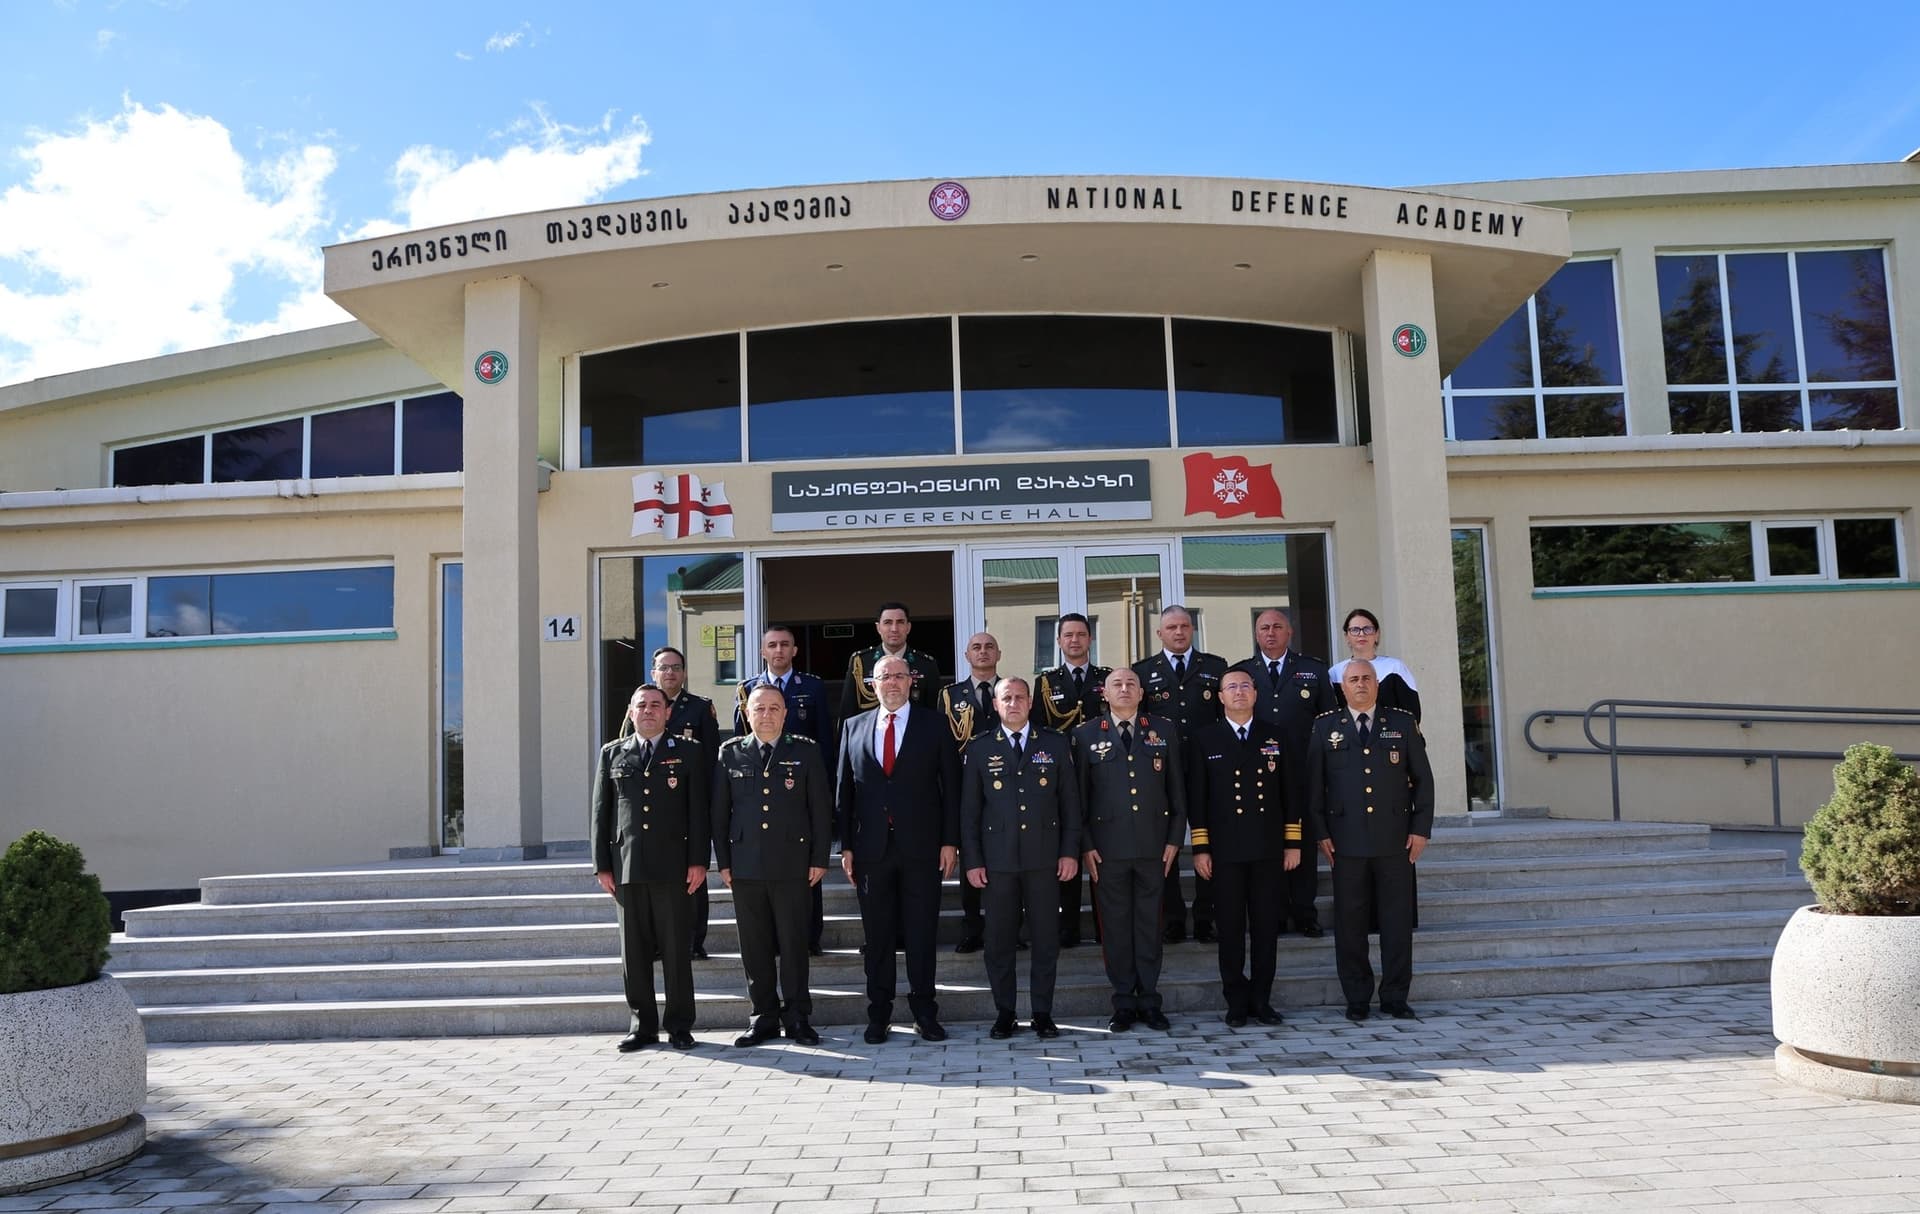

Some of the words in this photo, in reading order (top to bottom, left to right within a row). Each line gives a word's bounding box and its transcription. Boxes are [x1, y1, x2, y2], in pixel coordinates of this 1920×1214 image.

[1047, 187, 1182, 210] NATIONAL
[1232, 190, 1348, 219] DEFENCE
[1396, 202, 1524, 238] ACADEMY
[371, 229, 507, 271] ეროვნული
[546, 207, 688, 244] თავდაცვის
[728, 195, 851, 224] აკადემია
[788, 477, 1000, 498] საკონფერენციო
[1016, 473, 1134, 490] დარბაზი
[826, 510, 1012, 526] CONFERENCE
[1026, 506, 1098, 520] HALL
[548, 617, 575, 638] 14
